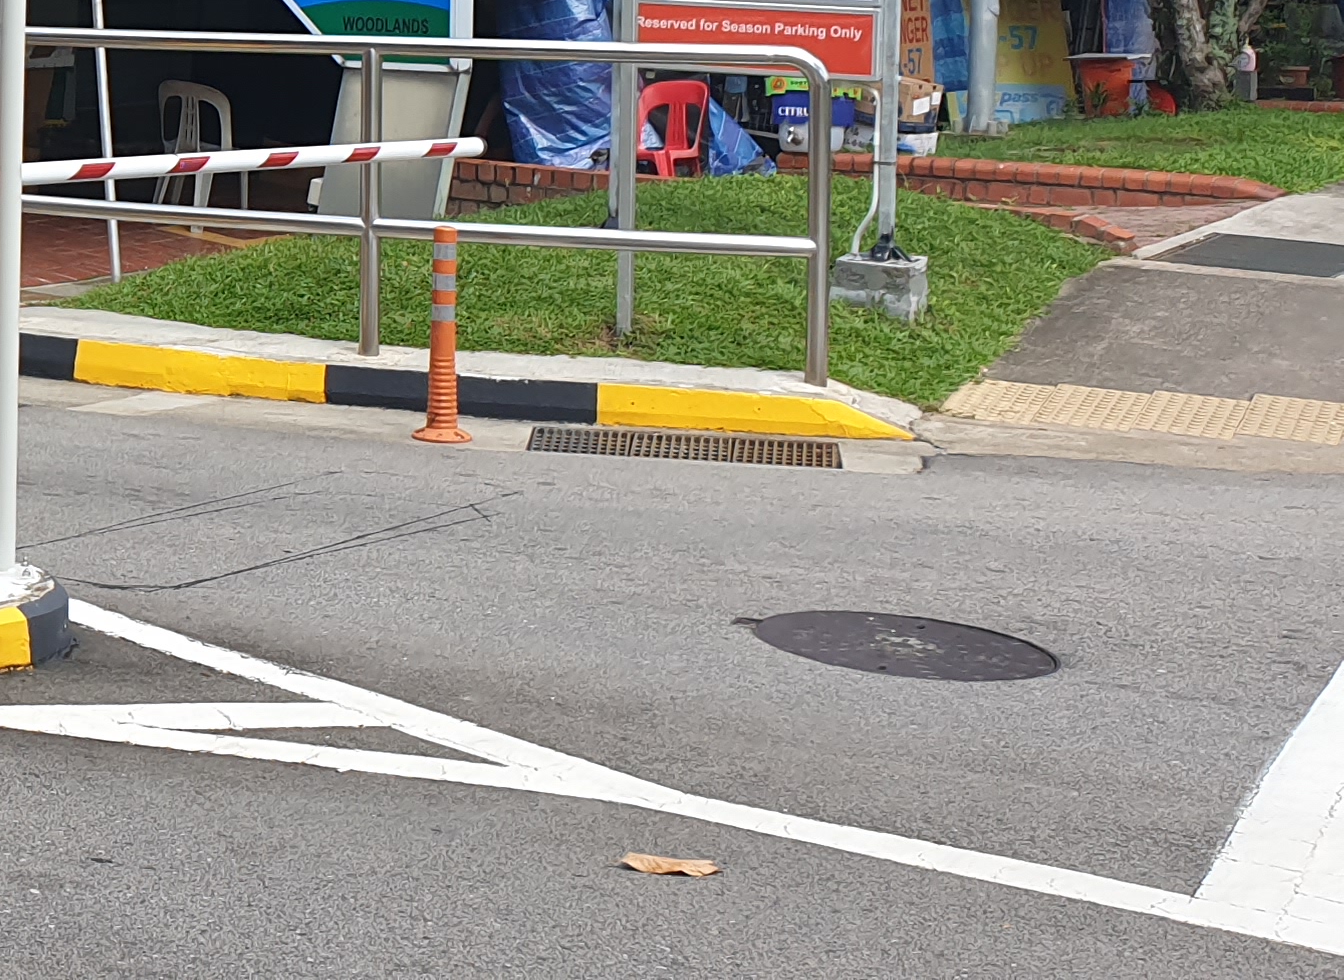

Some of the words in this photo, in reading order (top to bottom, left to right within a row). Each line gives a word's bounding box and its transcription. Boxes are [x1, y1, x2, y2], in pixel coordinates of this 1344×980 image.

[342, 16, 430, 35] WOODLANDS
[638, 16, 696, 31] Reserved
[700, 18, 717, 31] for
[721, 20, 771, 34] Season
[774, 23, 826, 39] Parking
[830, 25, 862, 41] Only
[901, 16, 929, 44] NGER
[999, 25, 1038, 50] -57
[903, 48, 923, 75] -57
[778, 106, 809, 117] CITRU
